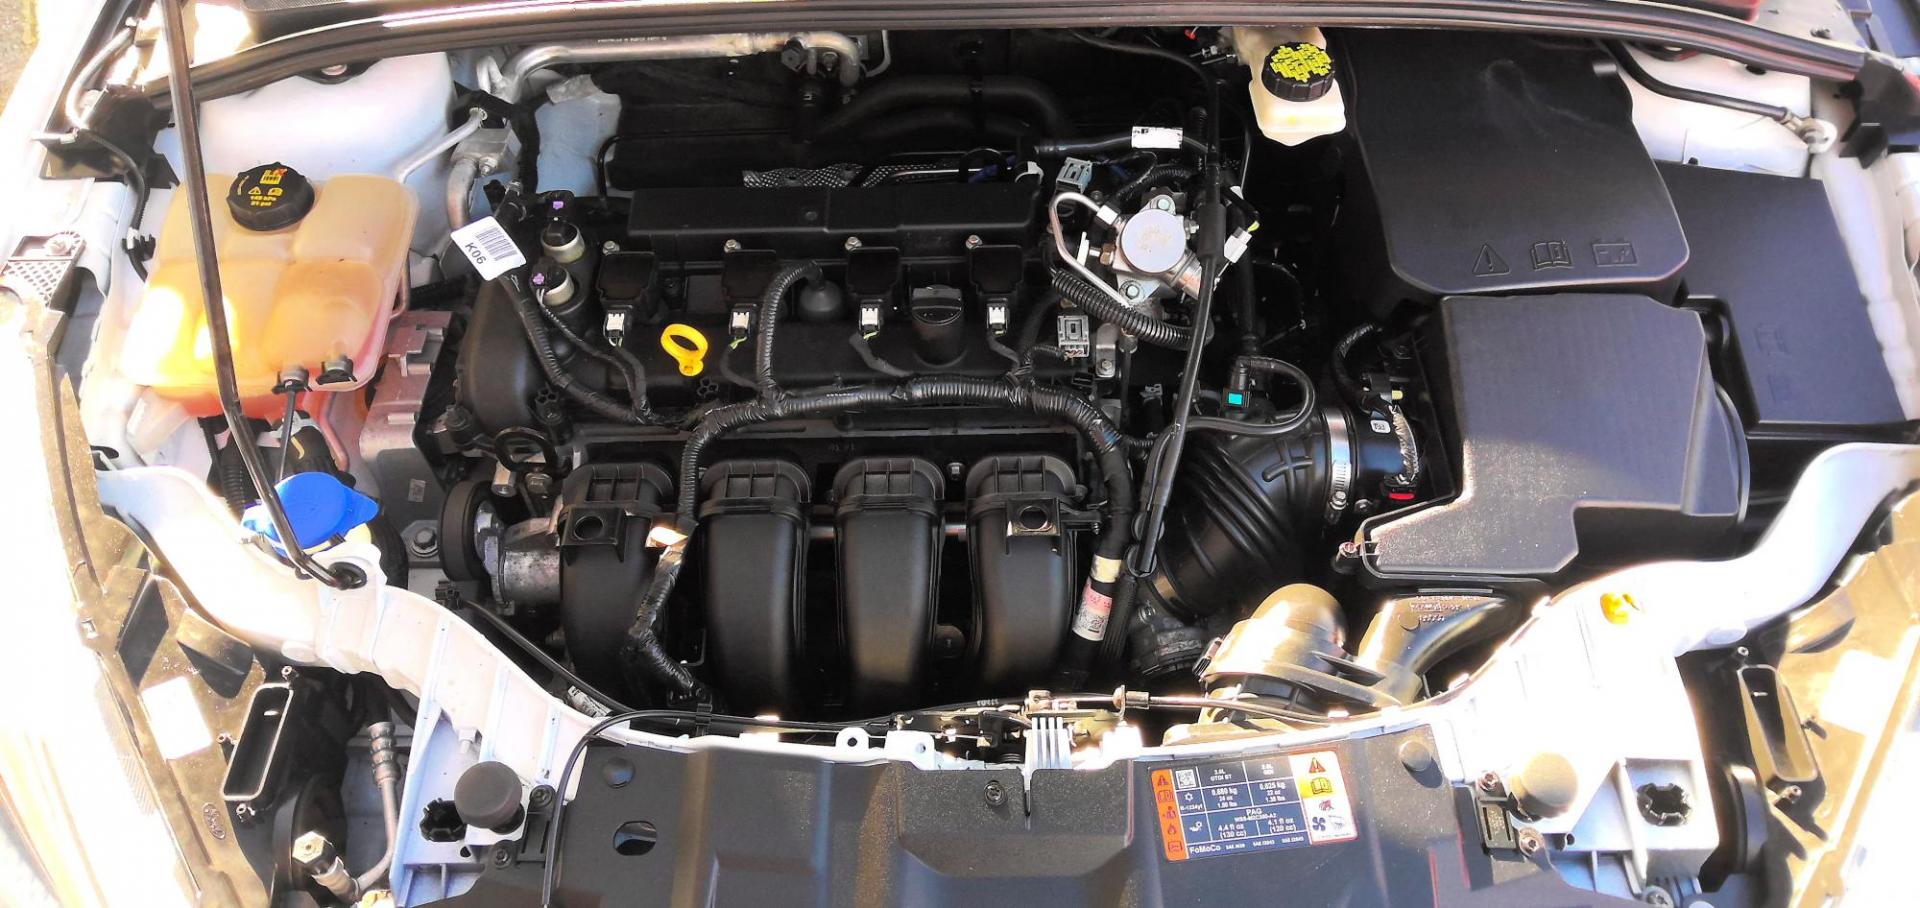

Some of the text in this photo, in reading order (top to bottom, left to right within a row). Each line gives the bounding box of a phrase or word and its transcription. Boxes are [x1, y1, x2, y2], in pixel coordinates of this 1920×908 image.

[465, 242, 487, 265] K06
[1245, 807, 1263, 816] PAG
[1189, 844, 1221, 854] FoMoCo
